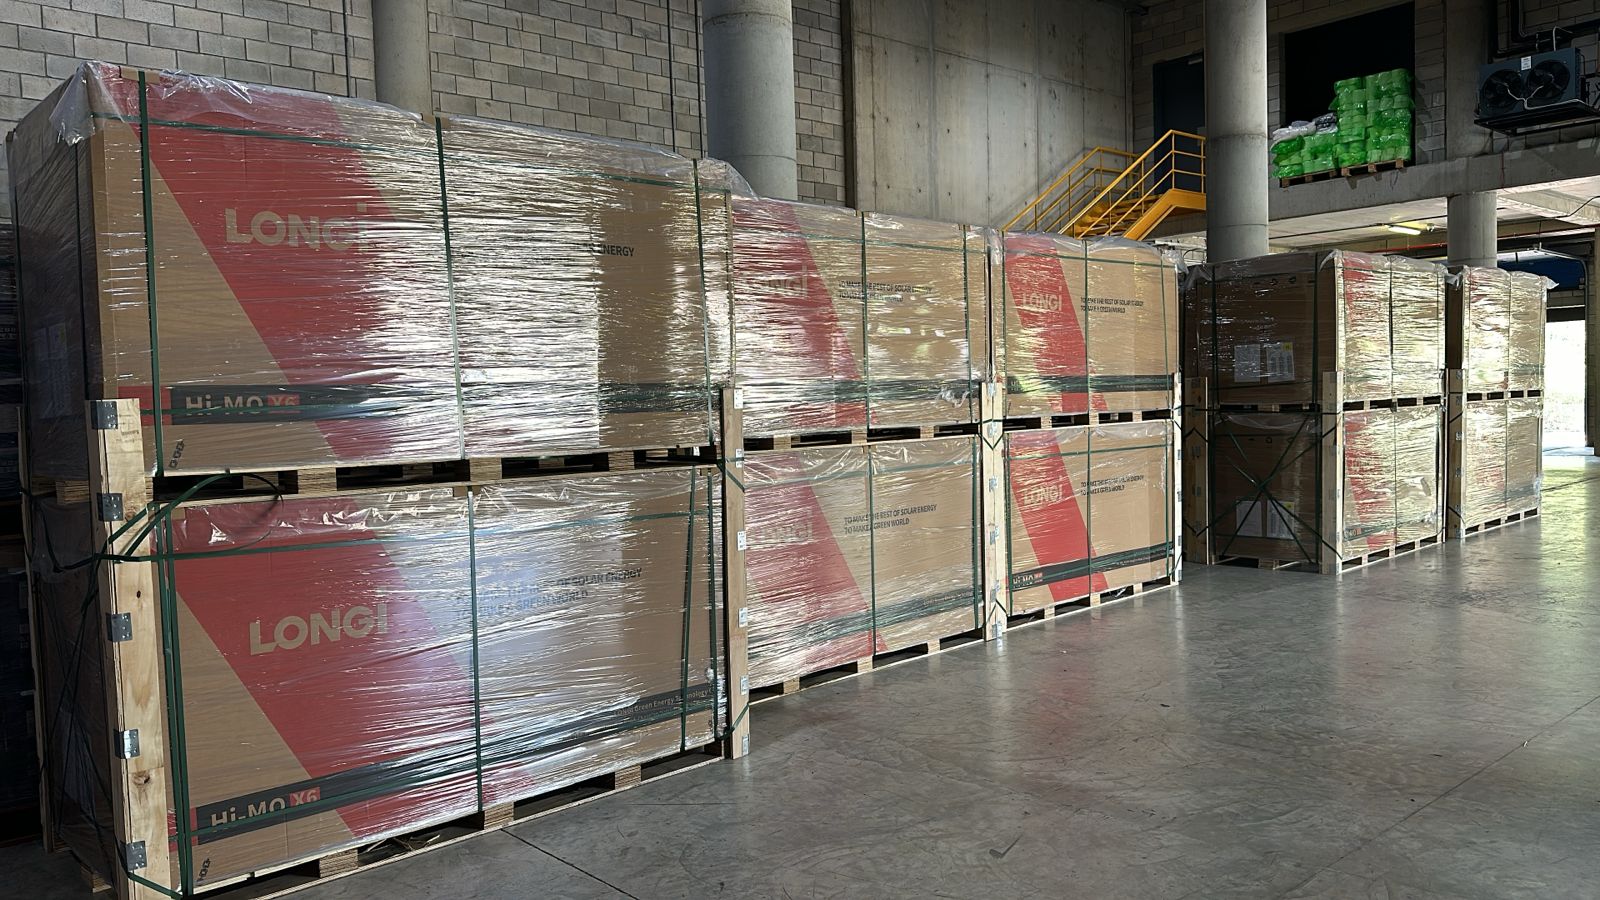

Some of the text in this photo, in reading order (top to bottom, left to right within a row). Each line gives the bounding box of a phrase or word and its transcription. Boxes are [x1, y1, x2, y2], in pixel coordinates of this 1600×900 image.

[186, 394, 265, 416] HiMO
[890, 516, 910, 527] WORLD
[674, 689, 709, 703] Tenology
[210, 797, 286, 833] Hi-MO
